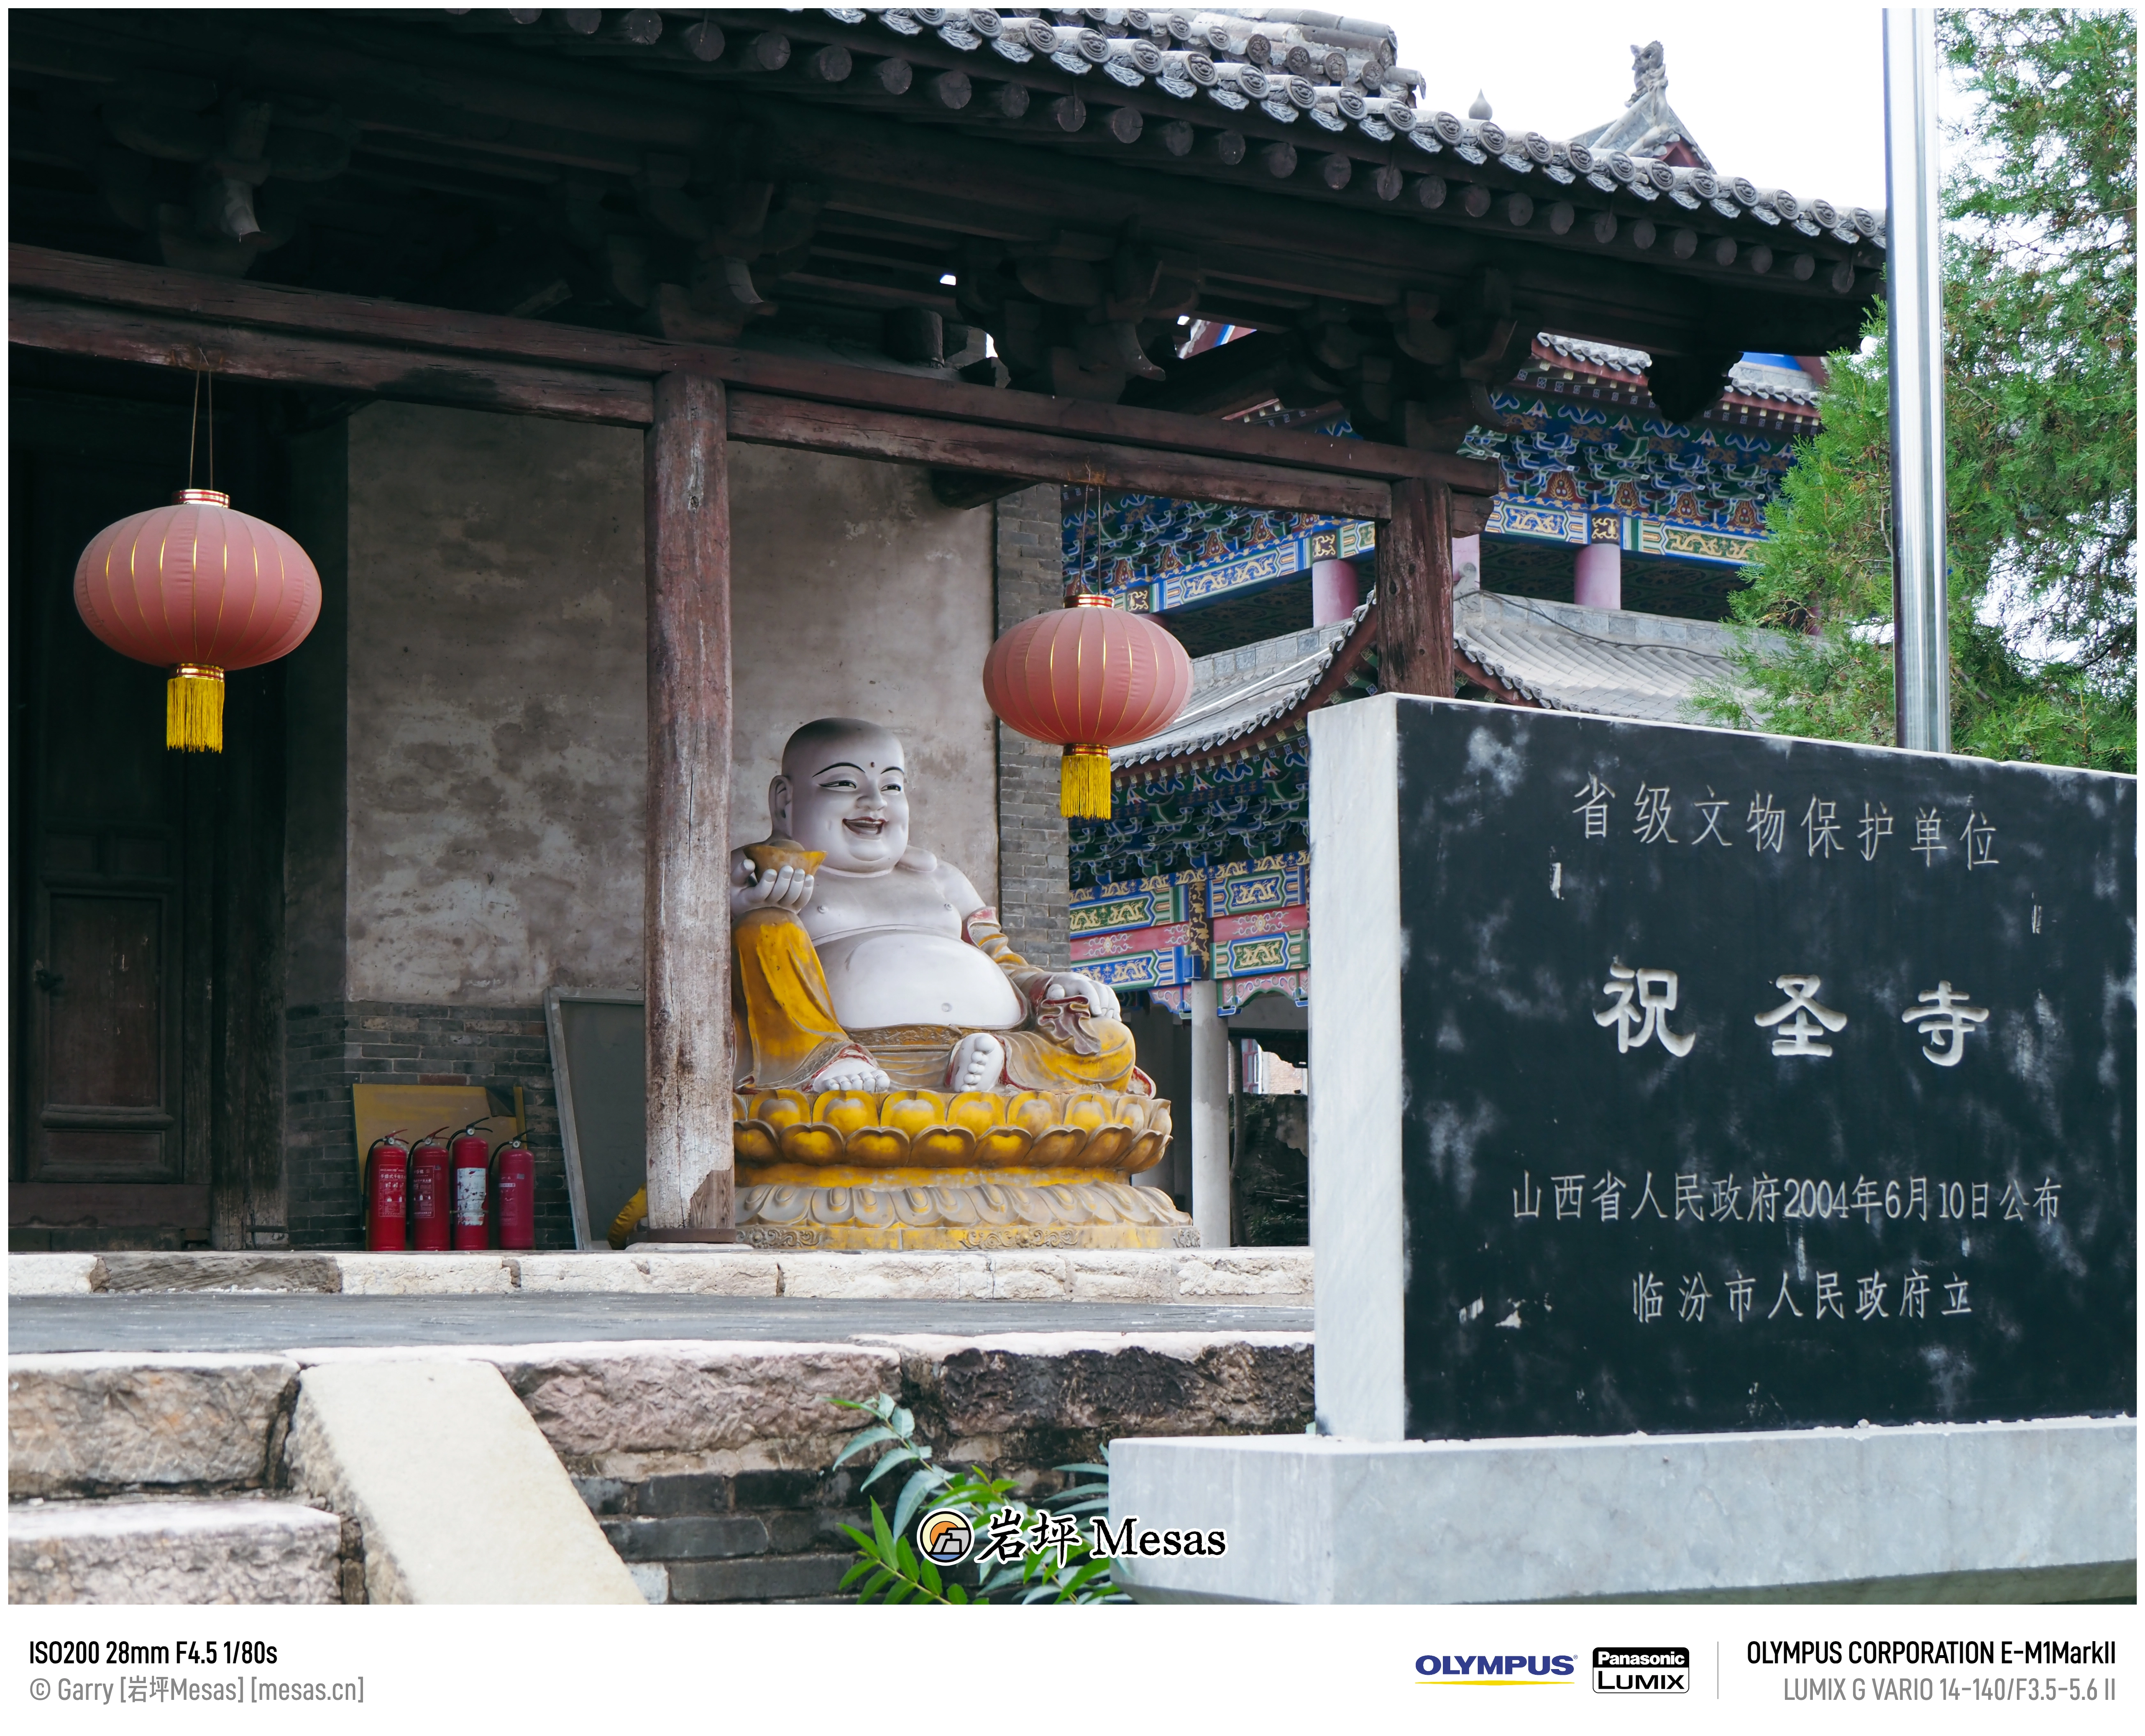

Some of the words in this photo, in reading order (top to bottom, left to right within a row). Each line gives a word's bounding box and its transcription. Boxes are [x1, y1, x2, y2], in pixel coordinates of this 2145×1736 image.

[1572, 772, 1999, 870] 省级文物保护单位
[1593, 958, 1989, 1067] 祝圣寺
[1512, 1170, 2061, 1224] 山西省人民政府2004年6月10日公布
[1632, 1269, 1973, 1323] 临汾市人民政府立
